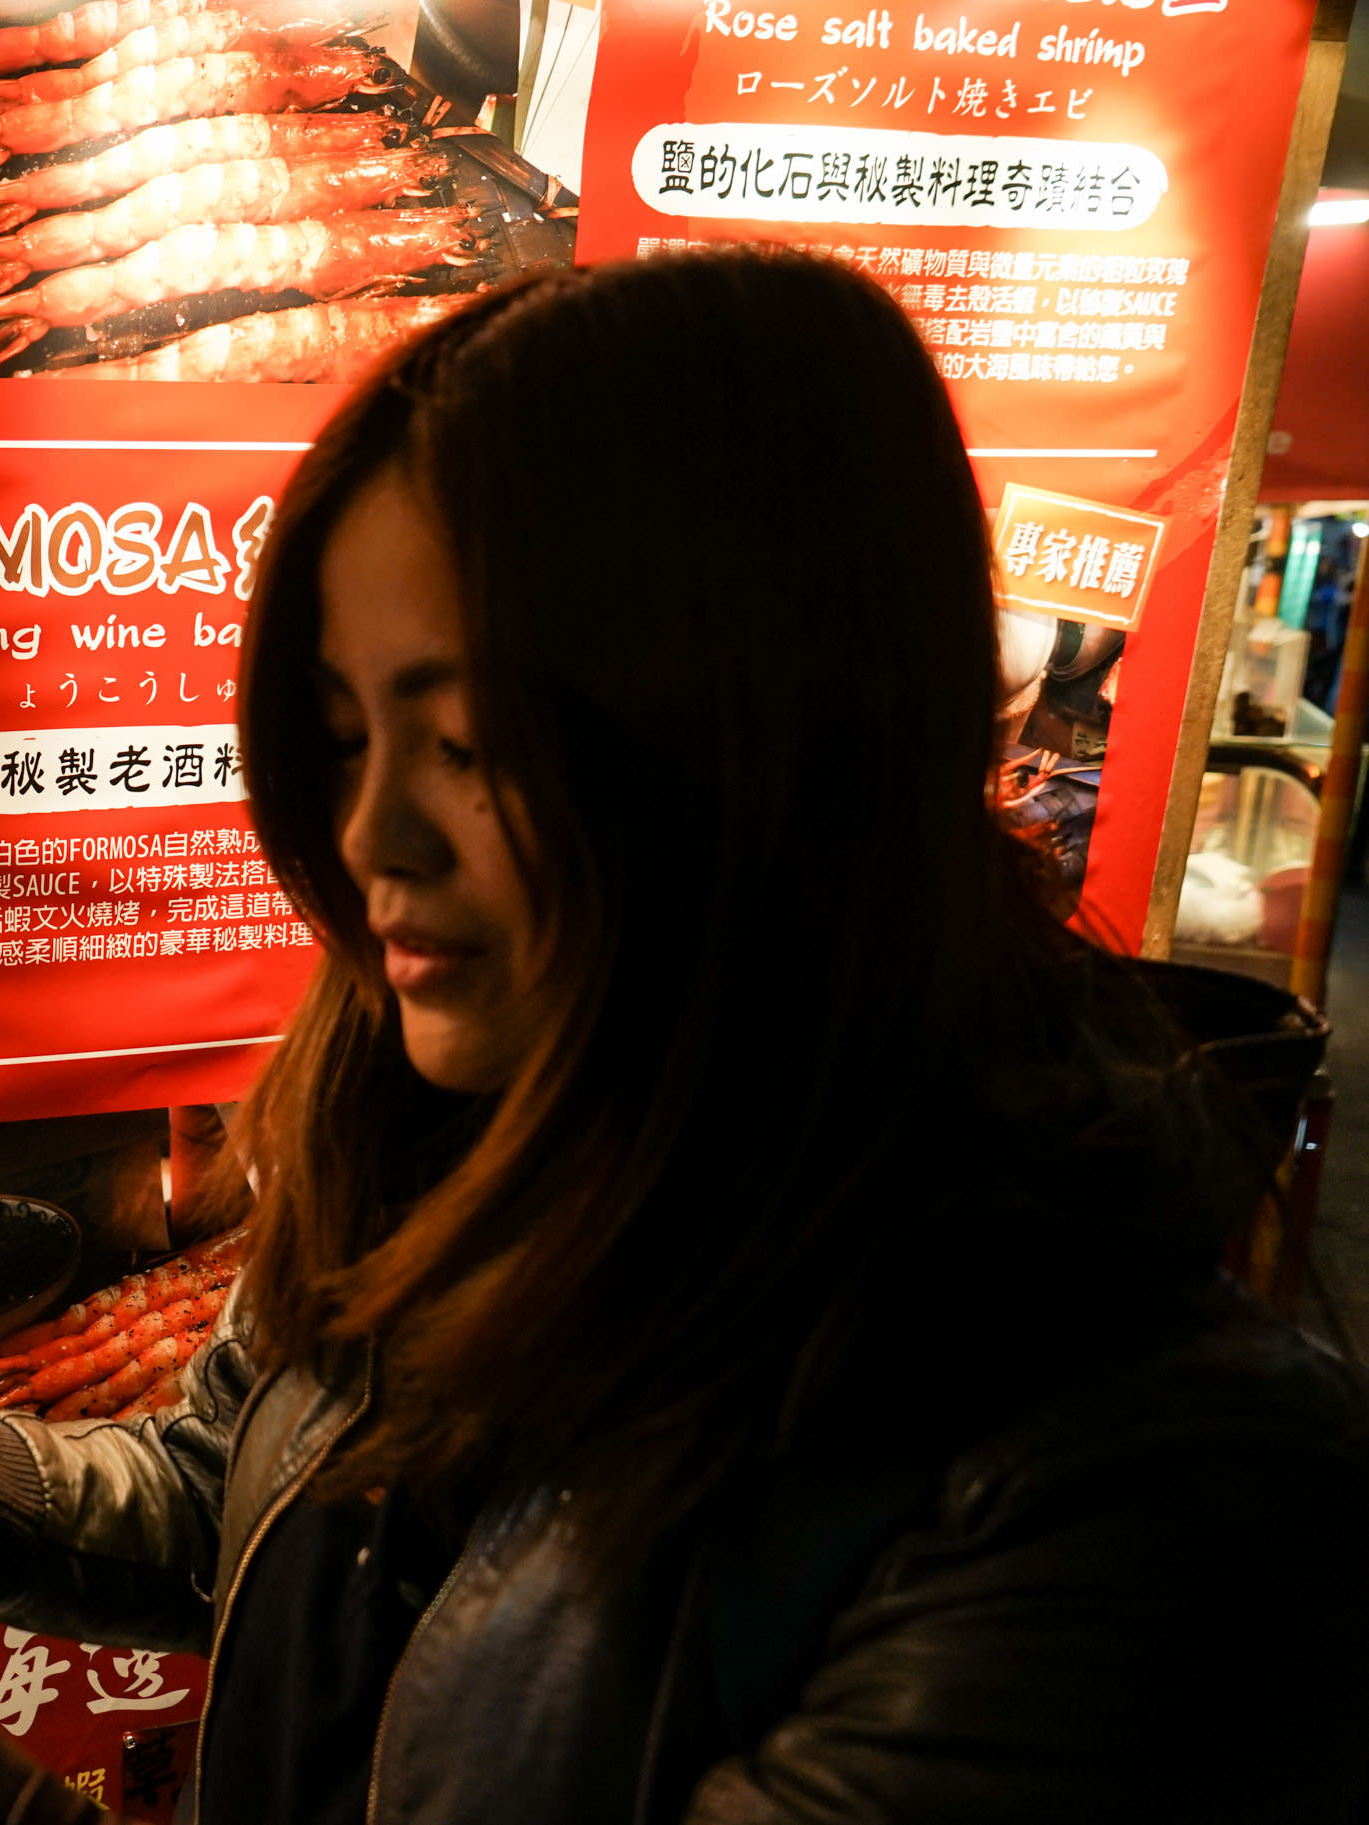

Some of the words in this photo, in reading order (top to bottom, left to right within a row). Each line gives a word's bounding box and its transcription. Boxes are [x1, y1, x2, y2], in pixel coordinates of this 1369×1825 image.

[704, 0, 799, 41] Rose
[821, 9, 893, 49] salt
[913, 13, 1020, 58] baked
[1037, 24, 1146, 78] shrimp
[736, 66, 1094, 120] ローズソルト焼きエビ
[932, 352, 1135, 383] 的大海風味帶給您。
[1003, 521, 1146, 598] 專家推薦
[71, 615, 167, 651] wine
[193, 611, 247, 648] ba
